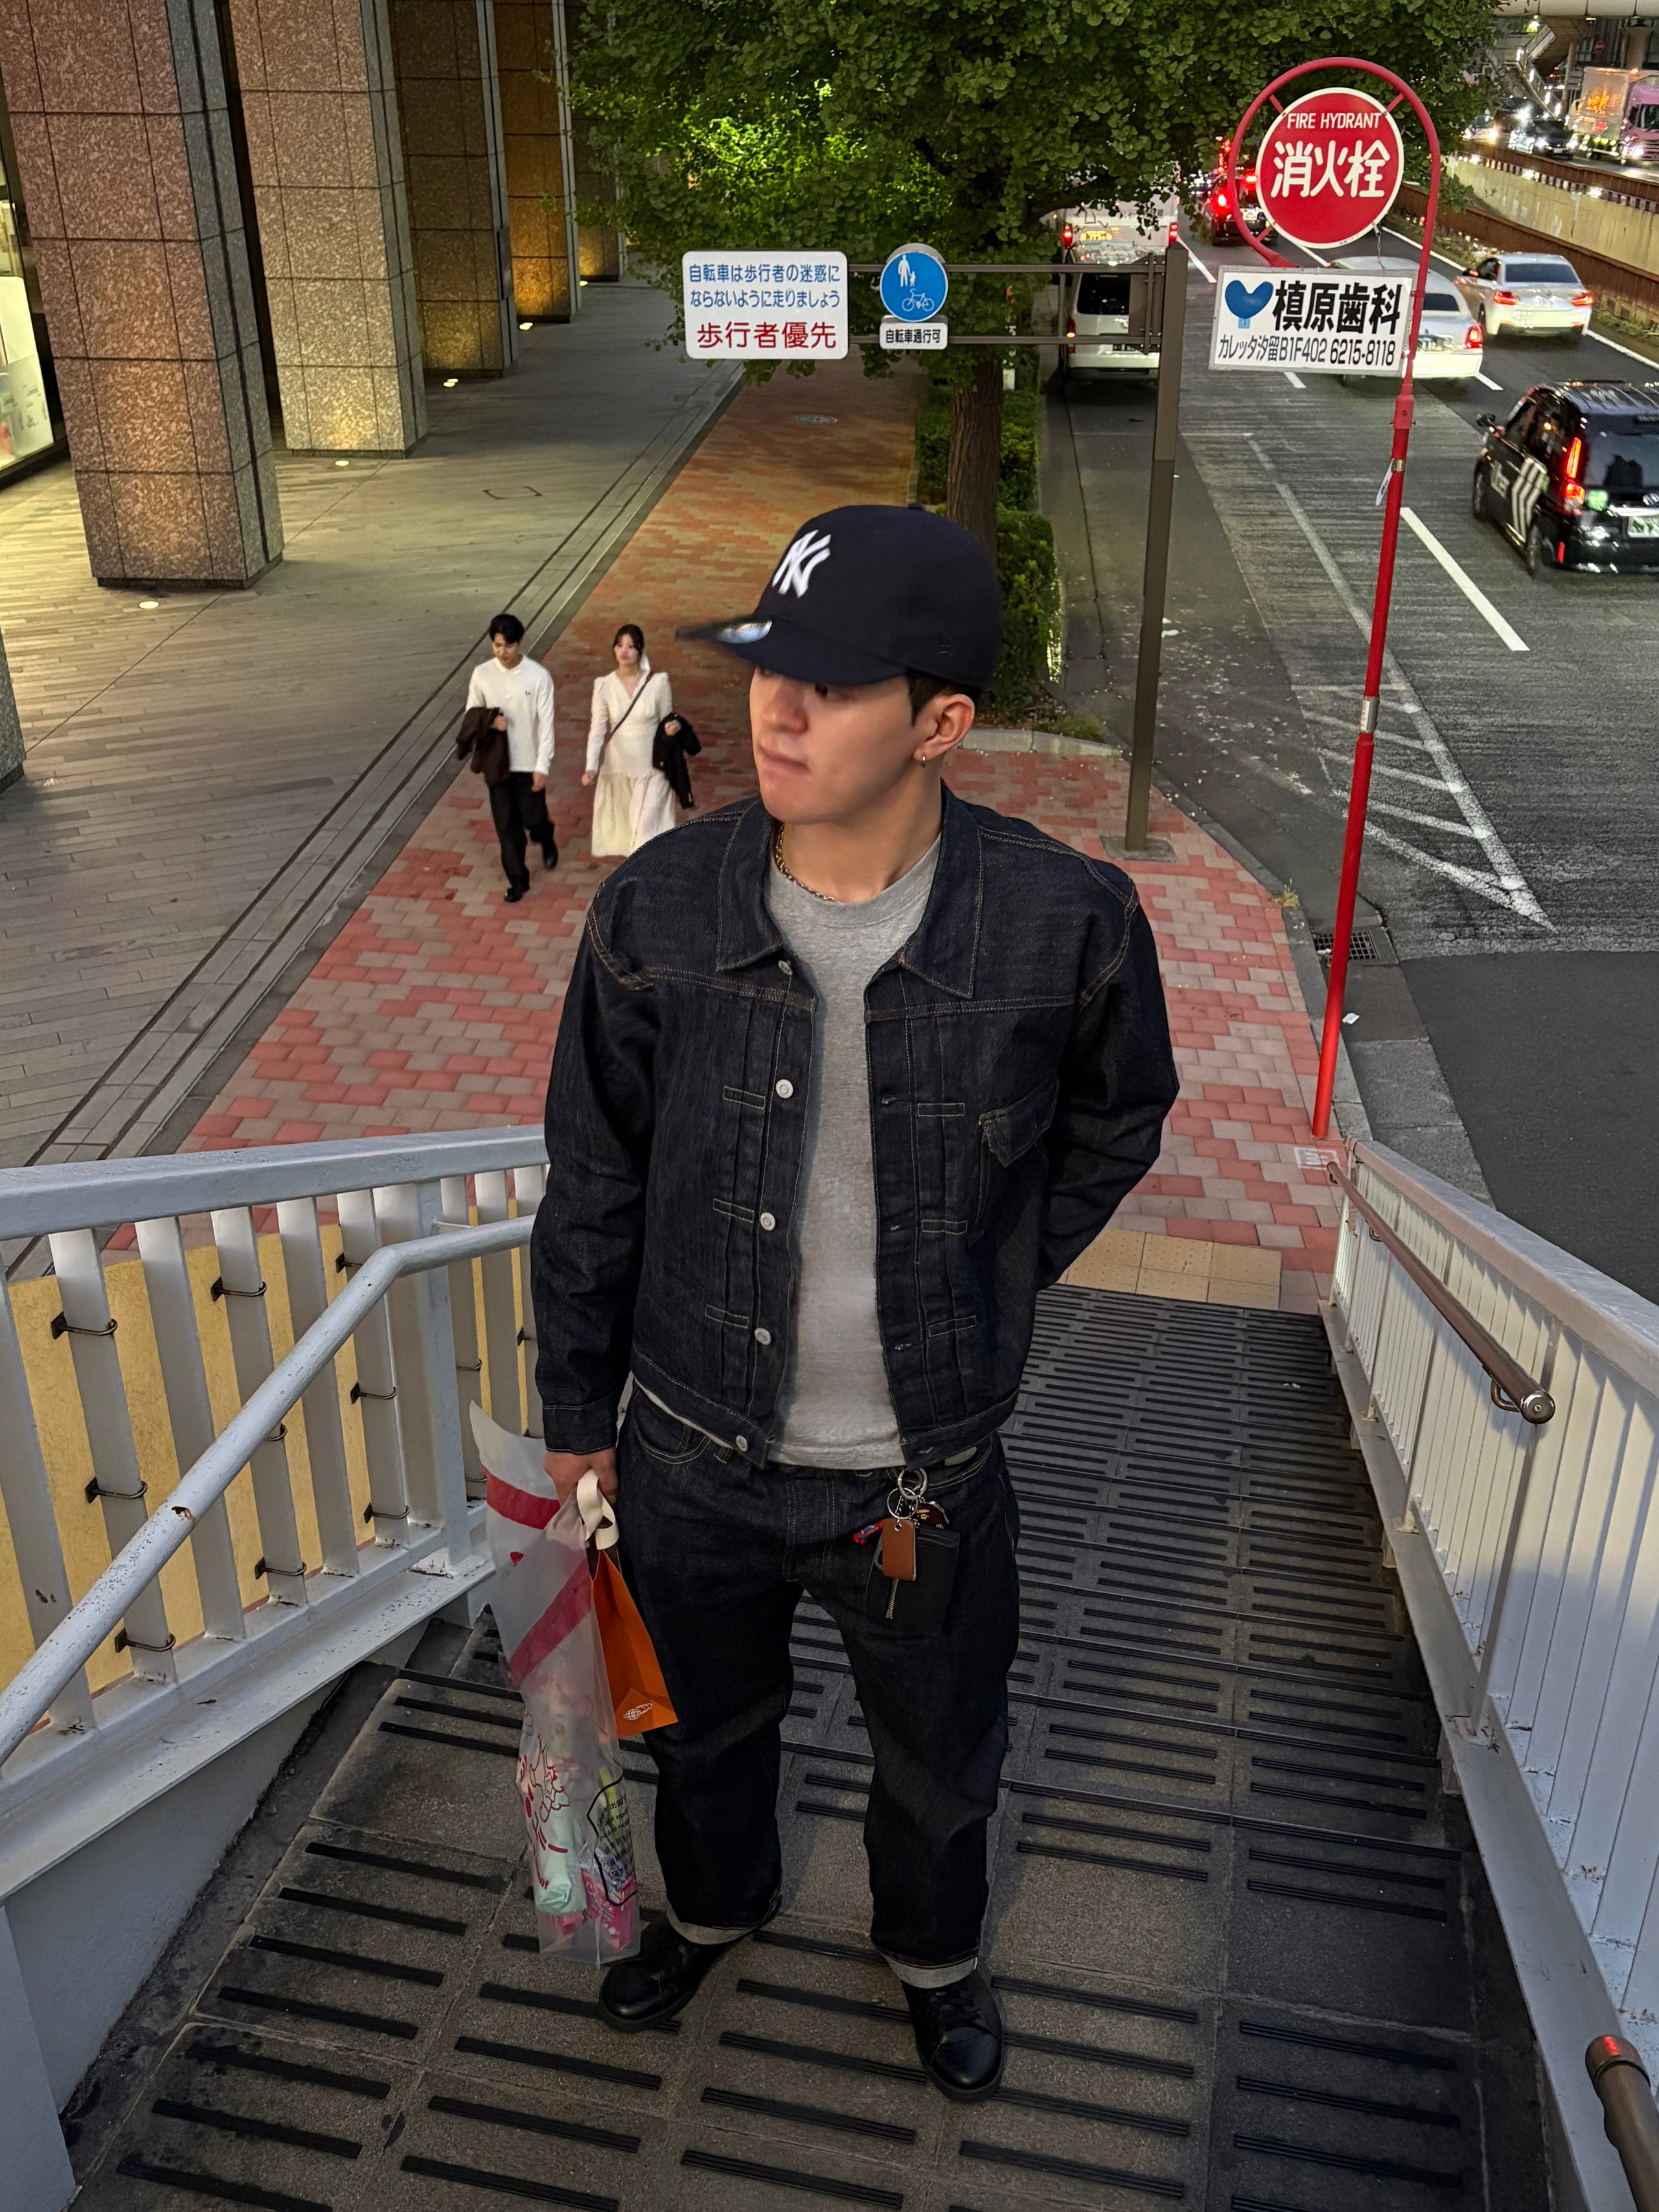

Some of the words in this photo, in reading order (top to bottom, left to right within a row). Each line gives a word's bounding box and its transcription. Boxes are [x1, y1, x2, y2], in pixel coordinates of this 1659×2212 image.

[1287, 113, 1316, 129] FIRE
[1320, 113, 1382, 129] HYDRANT
[1271, 139, 1390, 198] 消火栓
[689, 264, 840, 282] 自転車は歩行者の迷惑に
[691, 290, 840, 308] ならないように走りましょう
[697, 321, 836, 349] 歩行者優先
[886, 328, 941, 343] 自転車通行可
[1330, 338, 1396, 366] 6215-8118
[772, 530, 831, 598] NY
